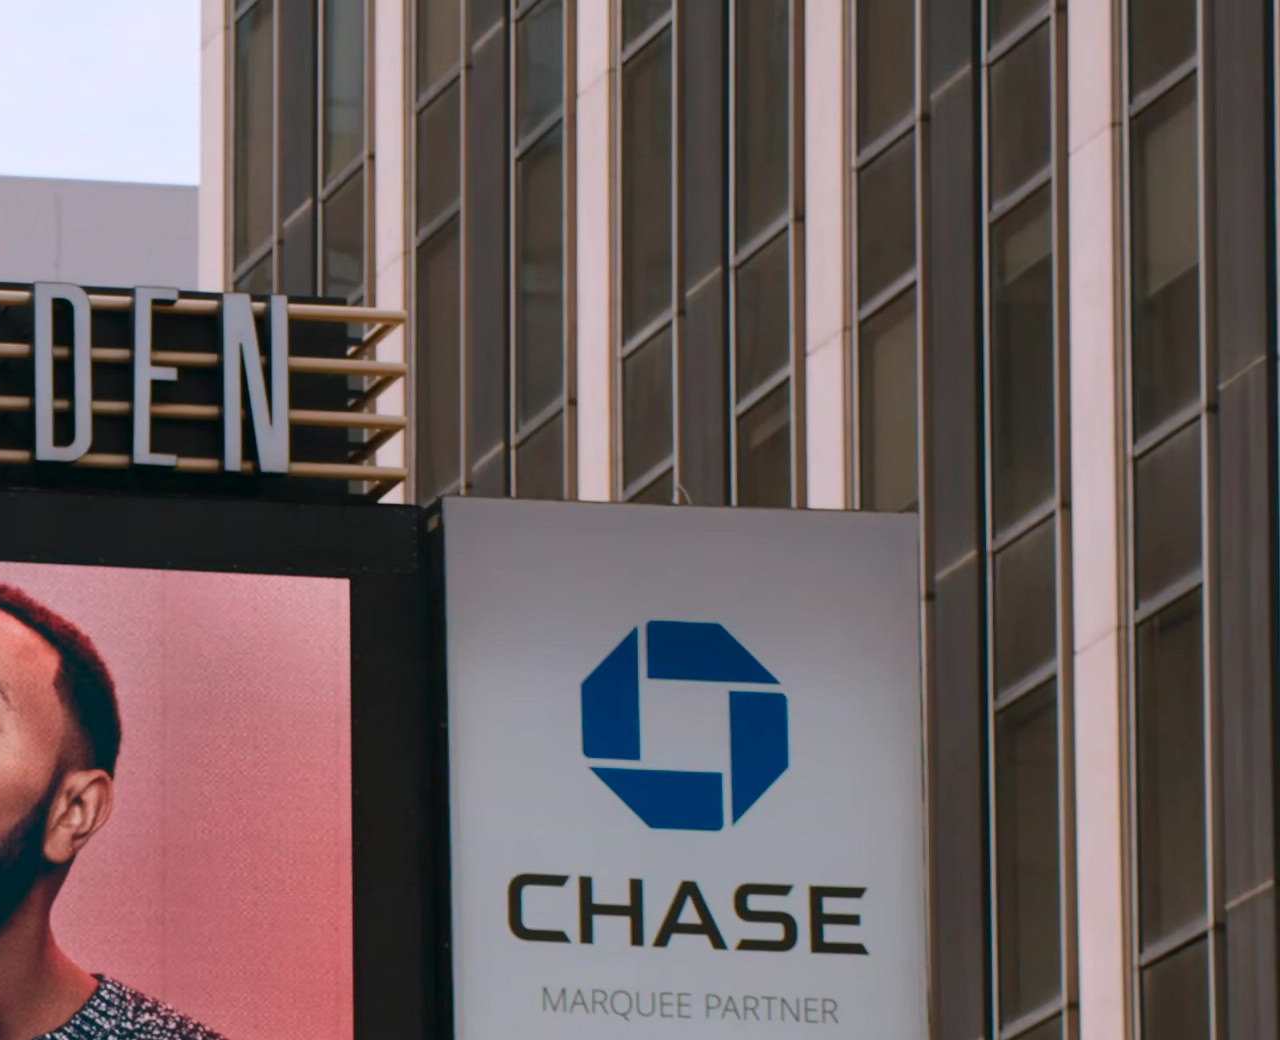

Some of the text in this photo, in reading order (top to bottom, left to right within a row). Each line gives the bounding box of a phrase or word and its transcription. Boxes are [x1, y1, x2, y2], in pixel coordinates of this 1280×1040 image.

[507, 873, 870, 956] CHASE
[541, 986, 839, 1024] MARQUEE PARTNER
